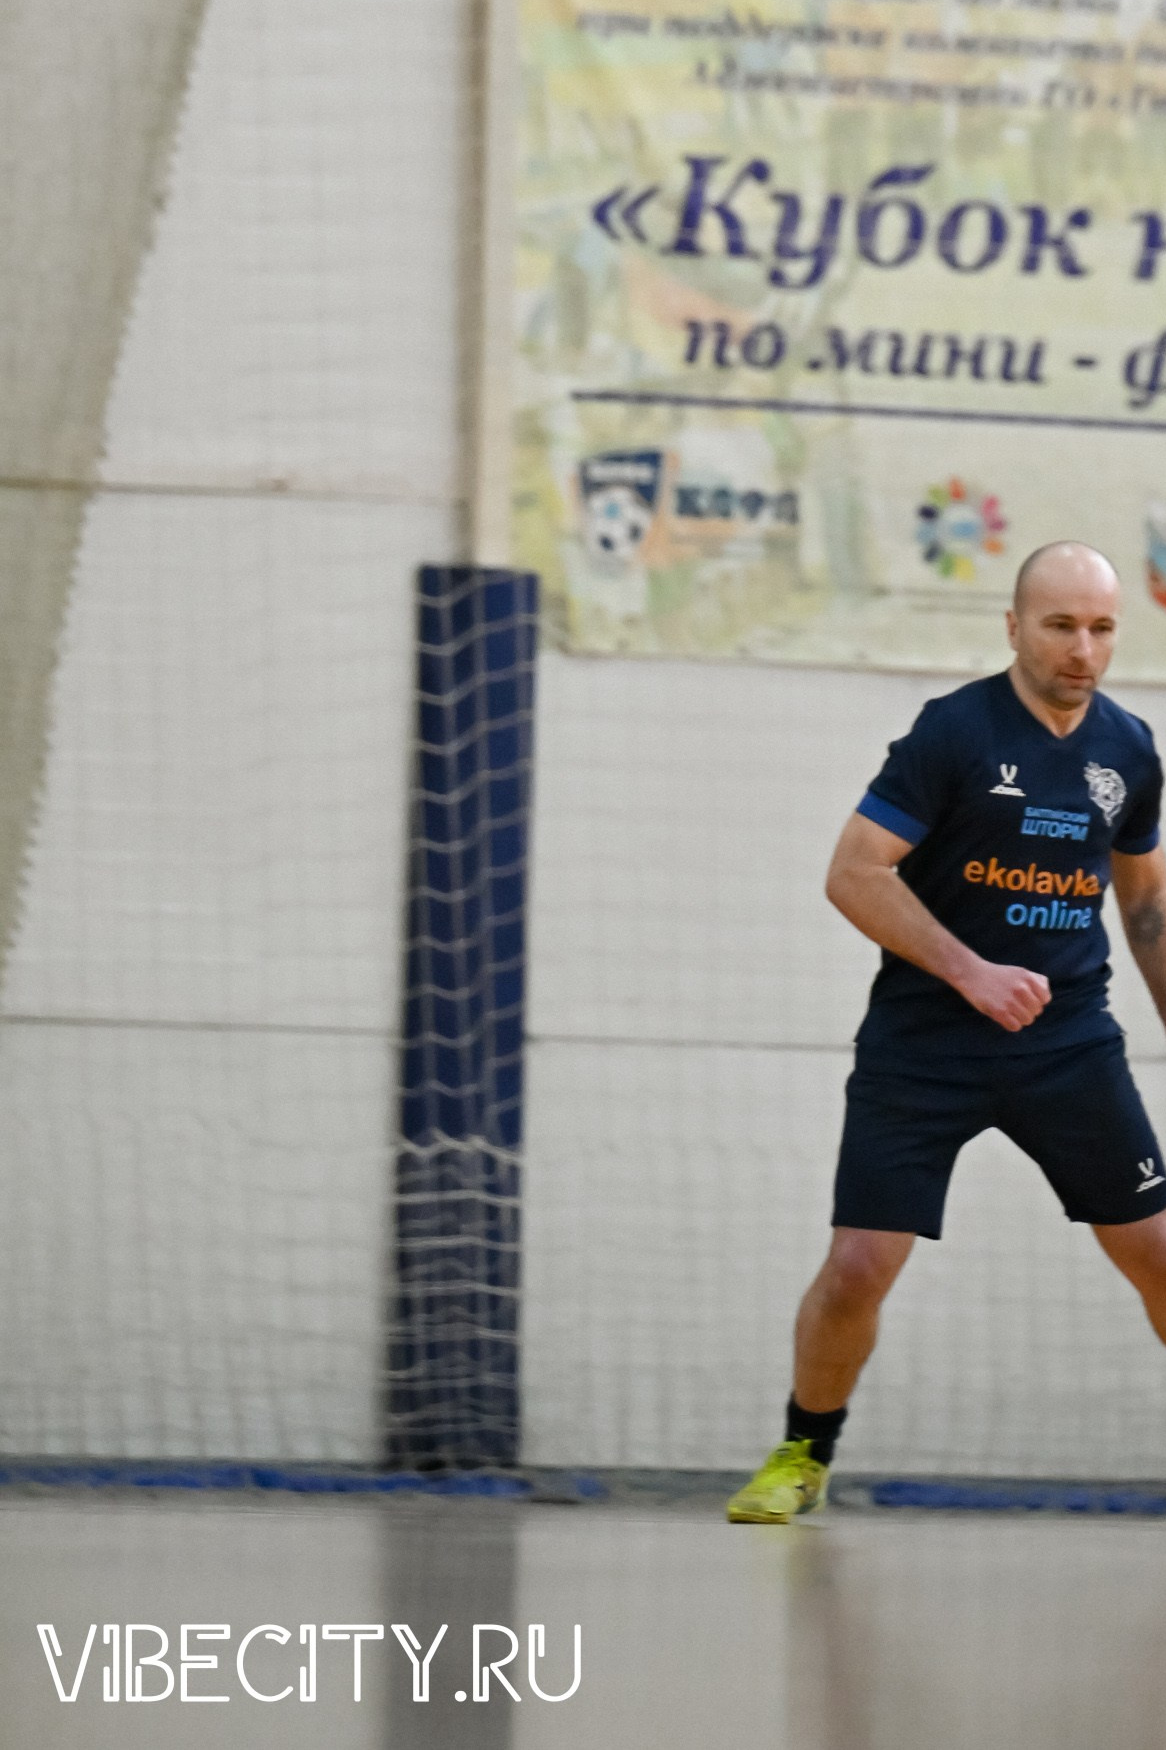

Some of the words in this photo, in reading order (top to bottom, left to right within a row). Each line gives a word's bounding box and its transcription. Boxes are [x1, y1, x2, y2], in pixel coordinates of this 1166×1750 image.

[590, 154, 1093, 290] «Кубок
[682, 319, 787, 371] по
[806, 325, 1048, 385] мини
[1020, 818, 1089, 841] ШТОРМ
